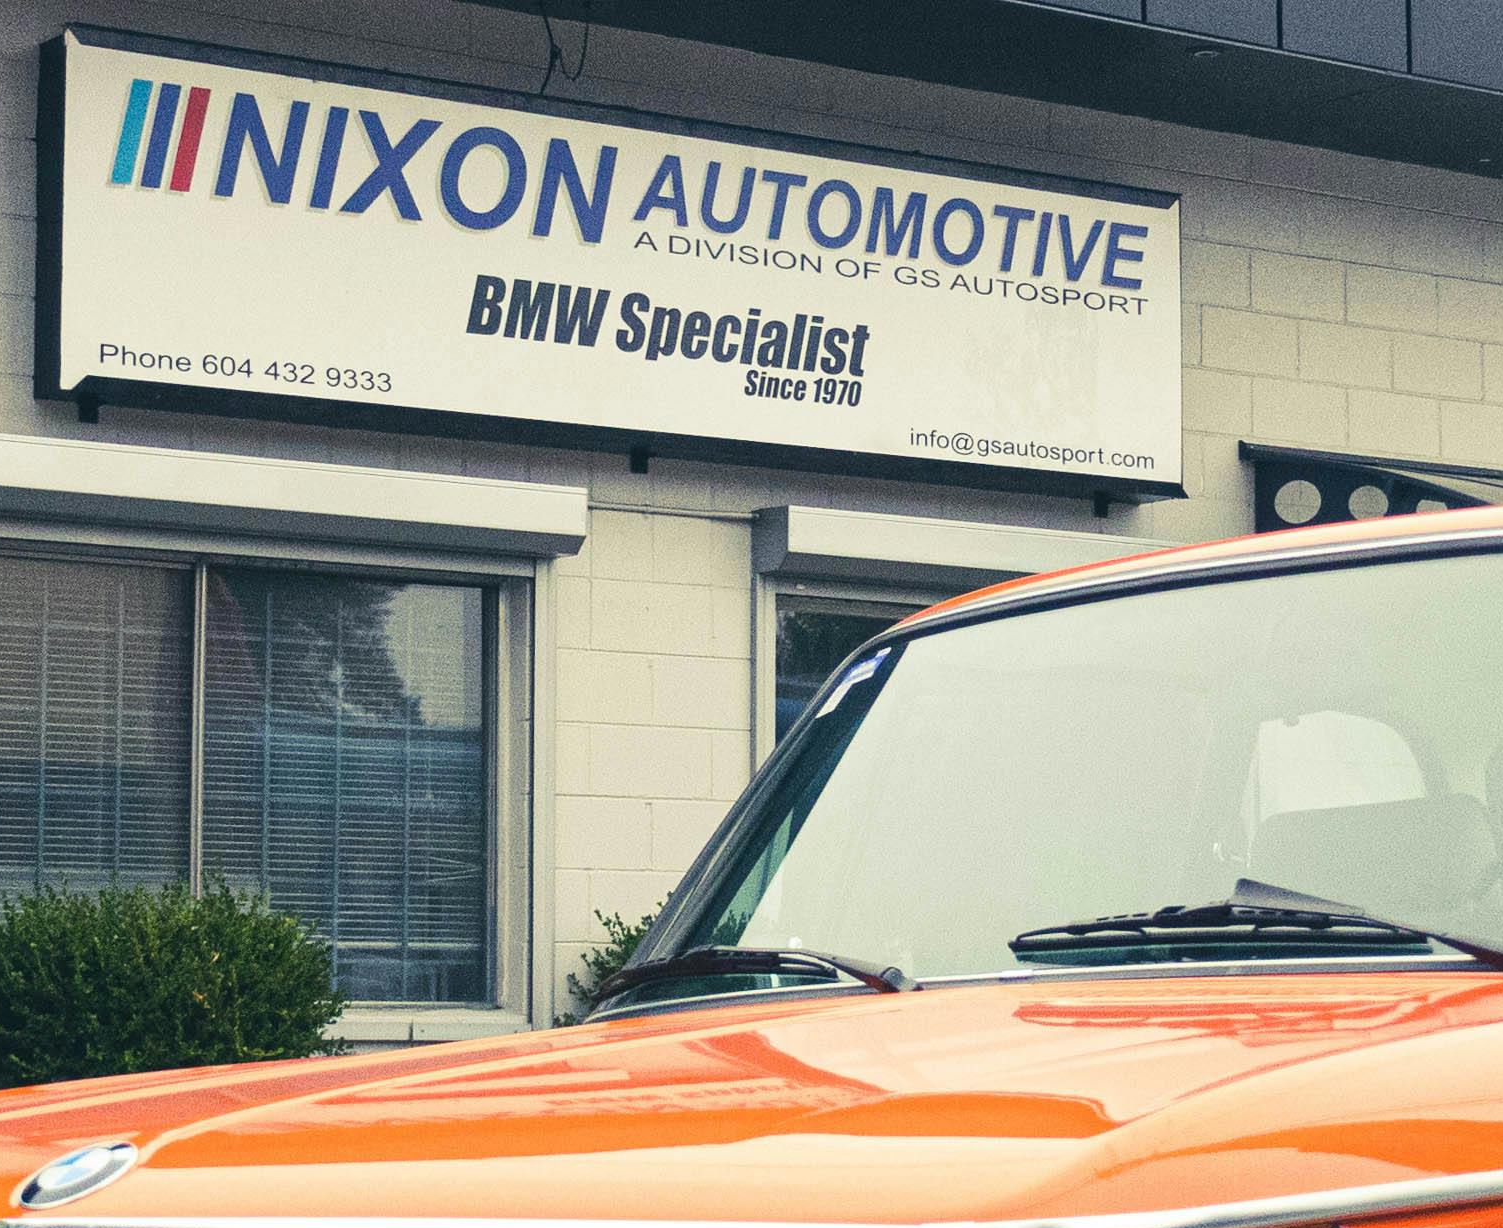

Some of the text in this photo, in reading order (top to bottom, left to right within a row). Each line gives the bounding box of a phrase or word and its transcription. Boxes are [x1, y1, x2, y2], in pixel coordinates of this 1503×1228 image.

[214, 91, 1149, 290] NIXON AUTOMOTIVE
[633, 231, 1149, 316] A DIVISION OF GS AUTOSPORT
[465, 274, 871, 378] BMW Specialist
[99, 343, 393, 393] Phone 604 432 9333
[744, 369, 863, 408] Since 1970
[909, 427, 1155, 470] info@gsautosport.com
